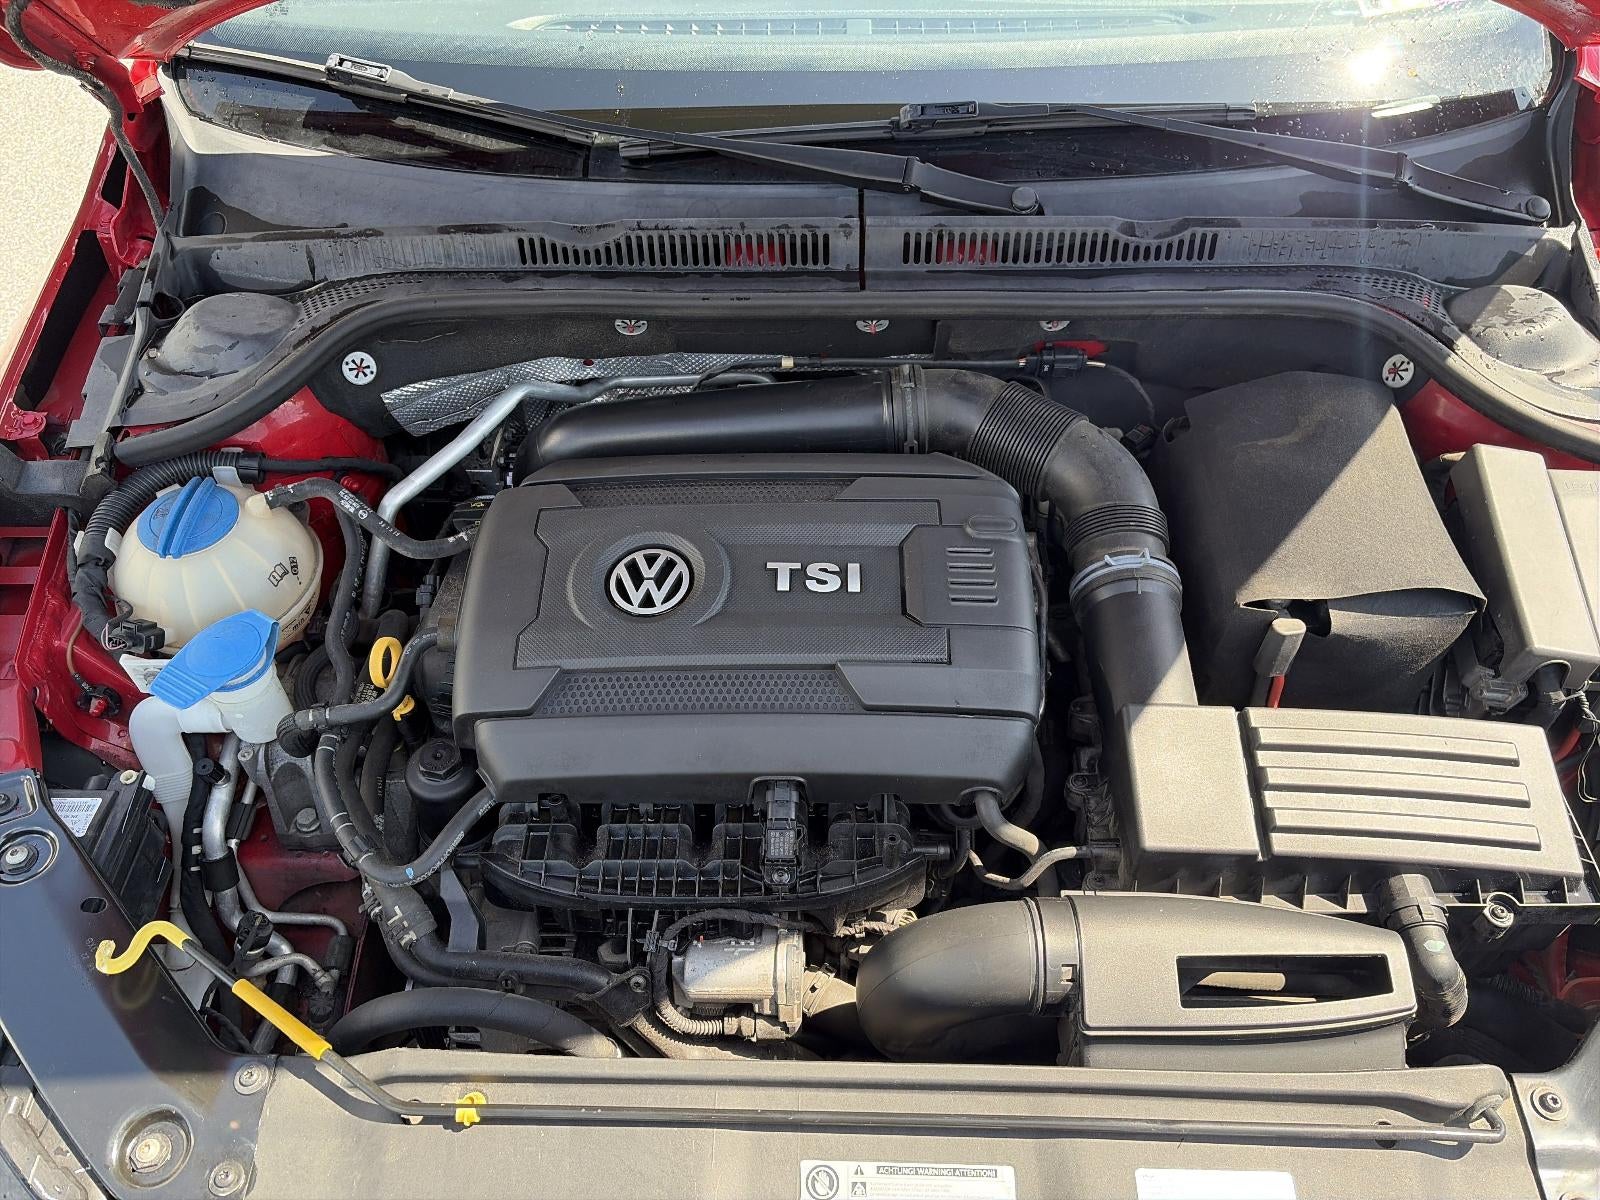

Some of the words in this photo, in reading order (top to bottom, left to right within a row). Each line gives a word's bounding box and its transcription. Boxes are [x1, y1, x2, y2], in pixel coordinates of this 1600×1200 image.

[766, 562, 861, 592] TSI
[878, 1165, 915, 1175] ACHTUNG!
[916, 1167, 953, 1177] WARNING!
[954, 1168, 997, 1178] ATTENTION!
